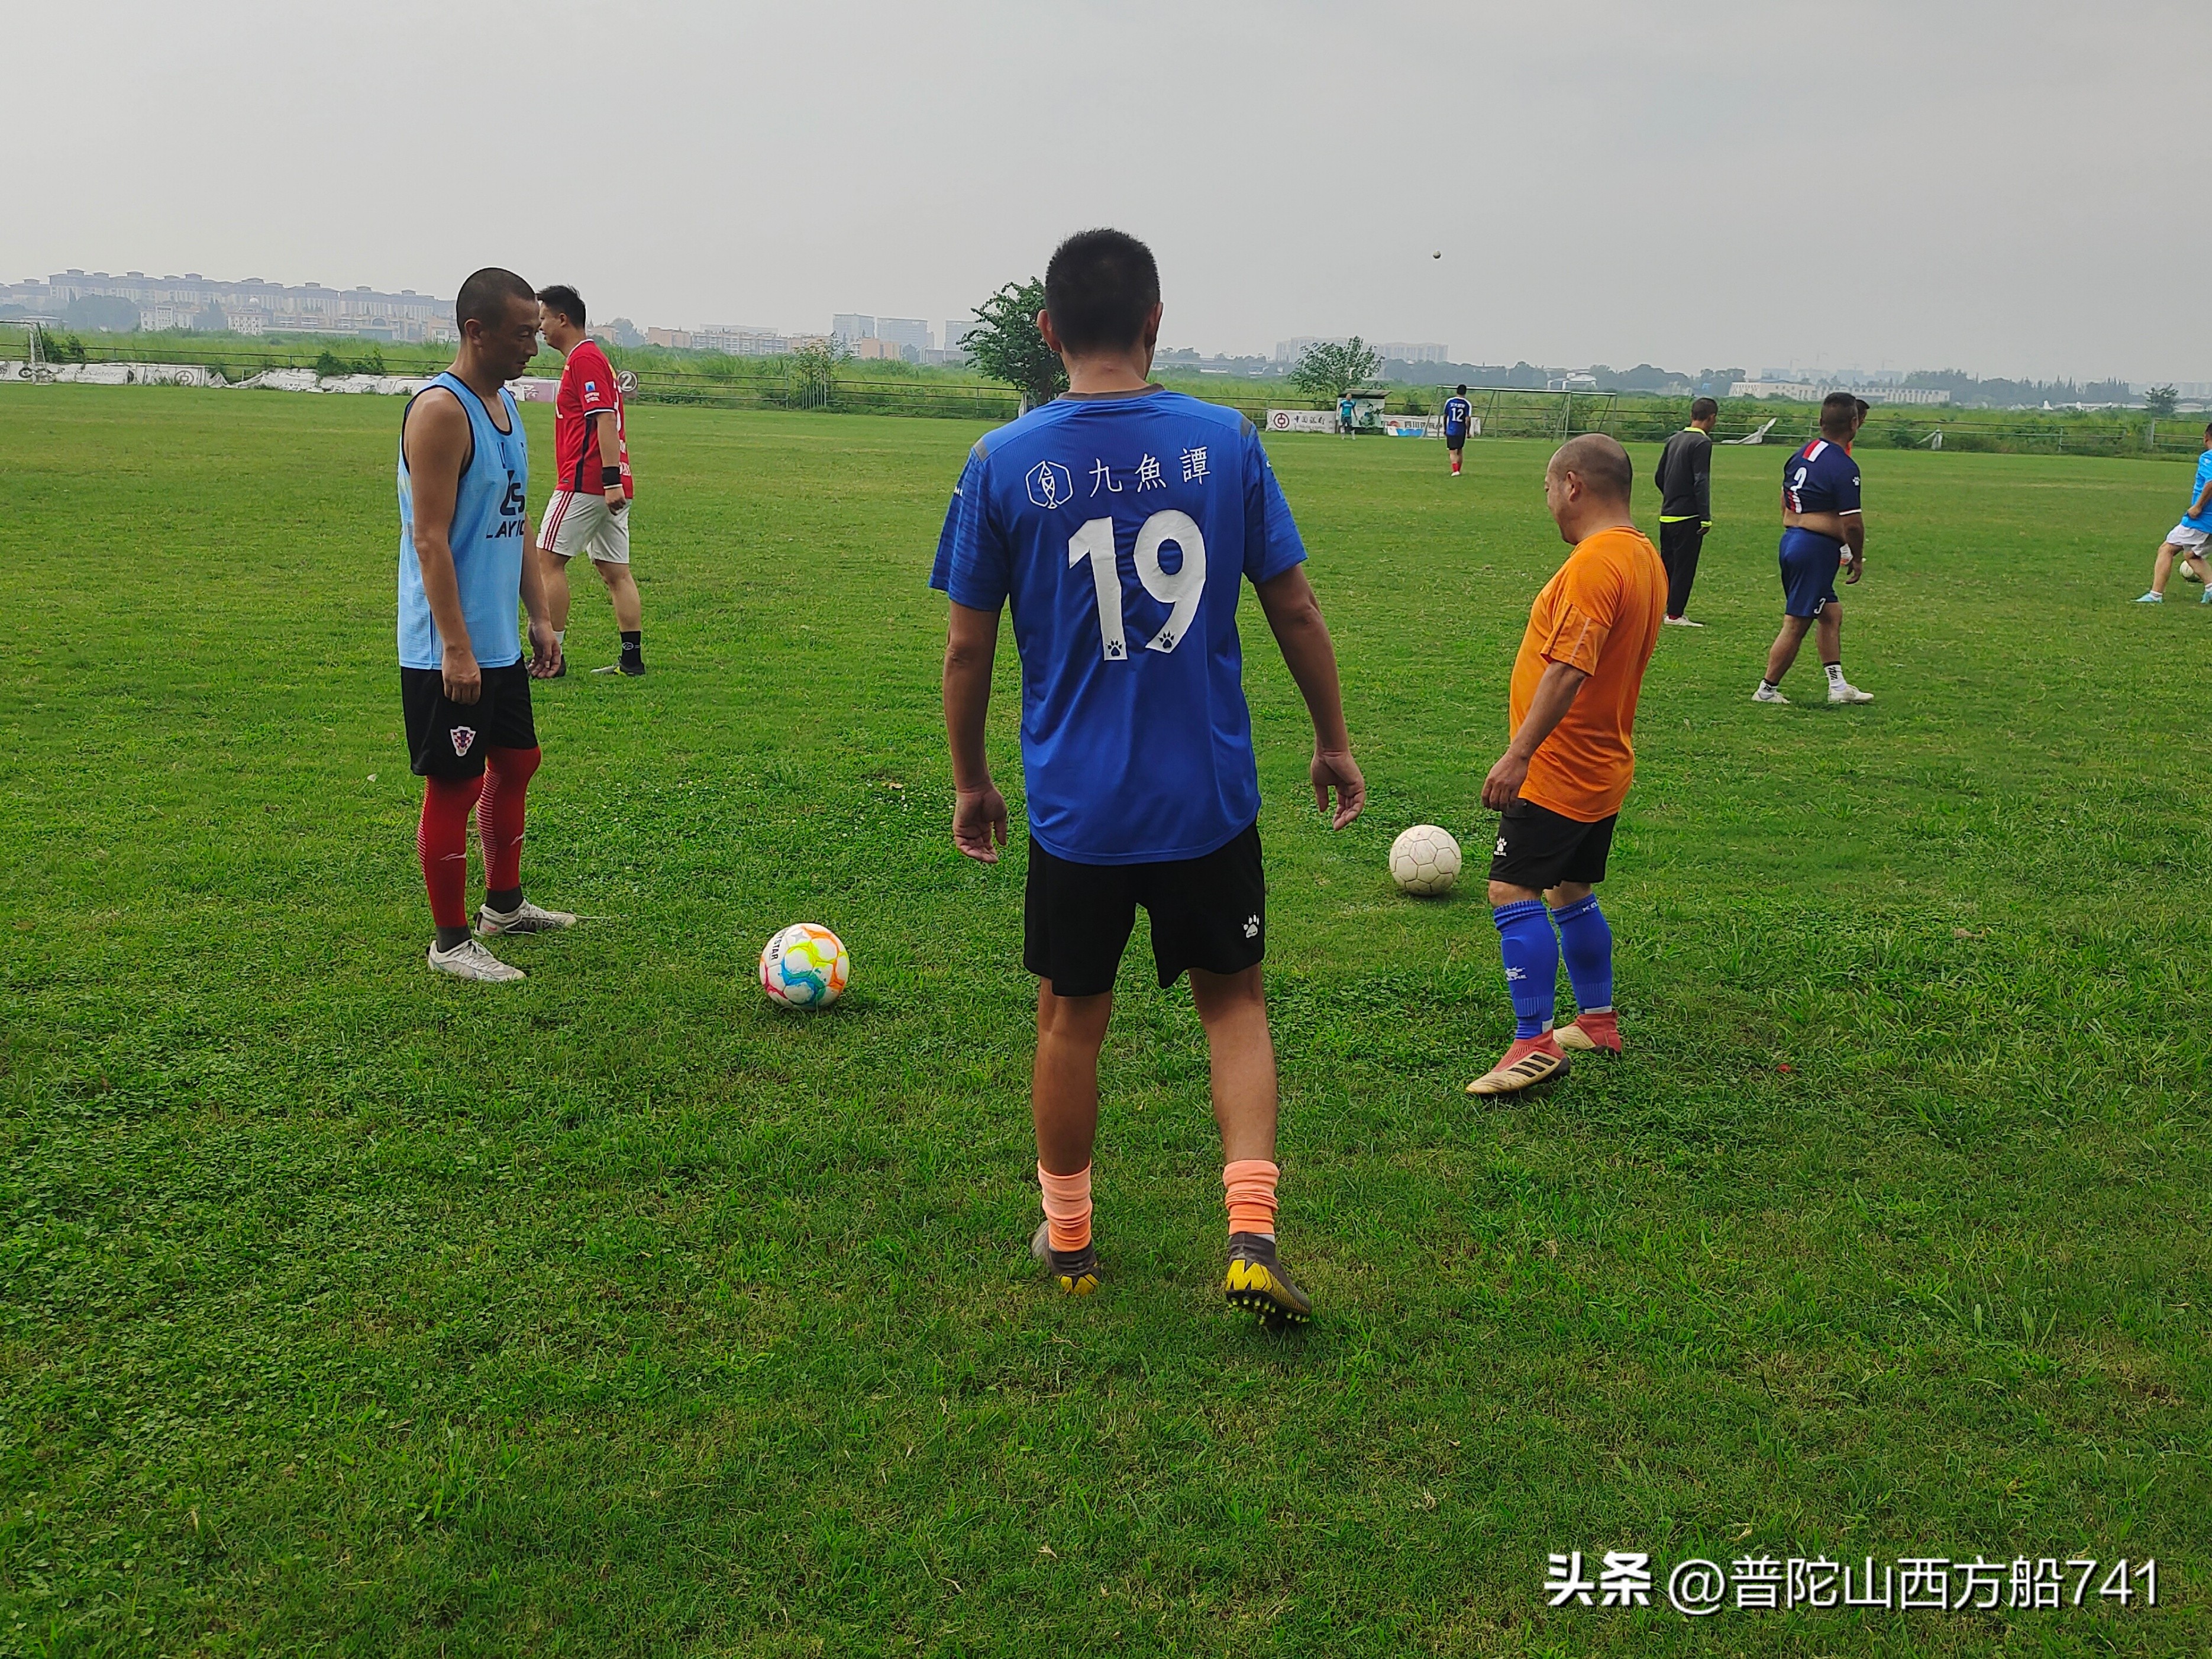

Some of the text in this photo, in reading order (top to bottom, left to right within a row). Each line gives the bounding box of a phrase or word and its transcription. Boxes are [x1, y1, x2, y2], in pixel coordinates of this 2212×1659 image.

[621, 372, 632, 389] 2
[1451, 407, 1464, 422] 12
[1068, 509, 1206, 661] 19
